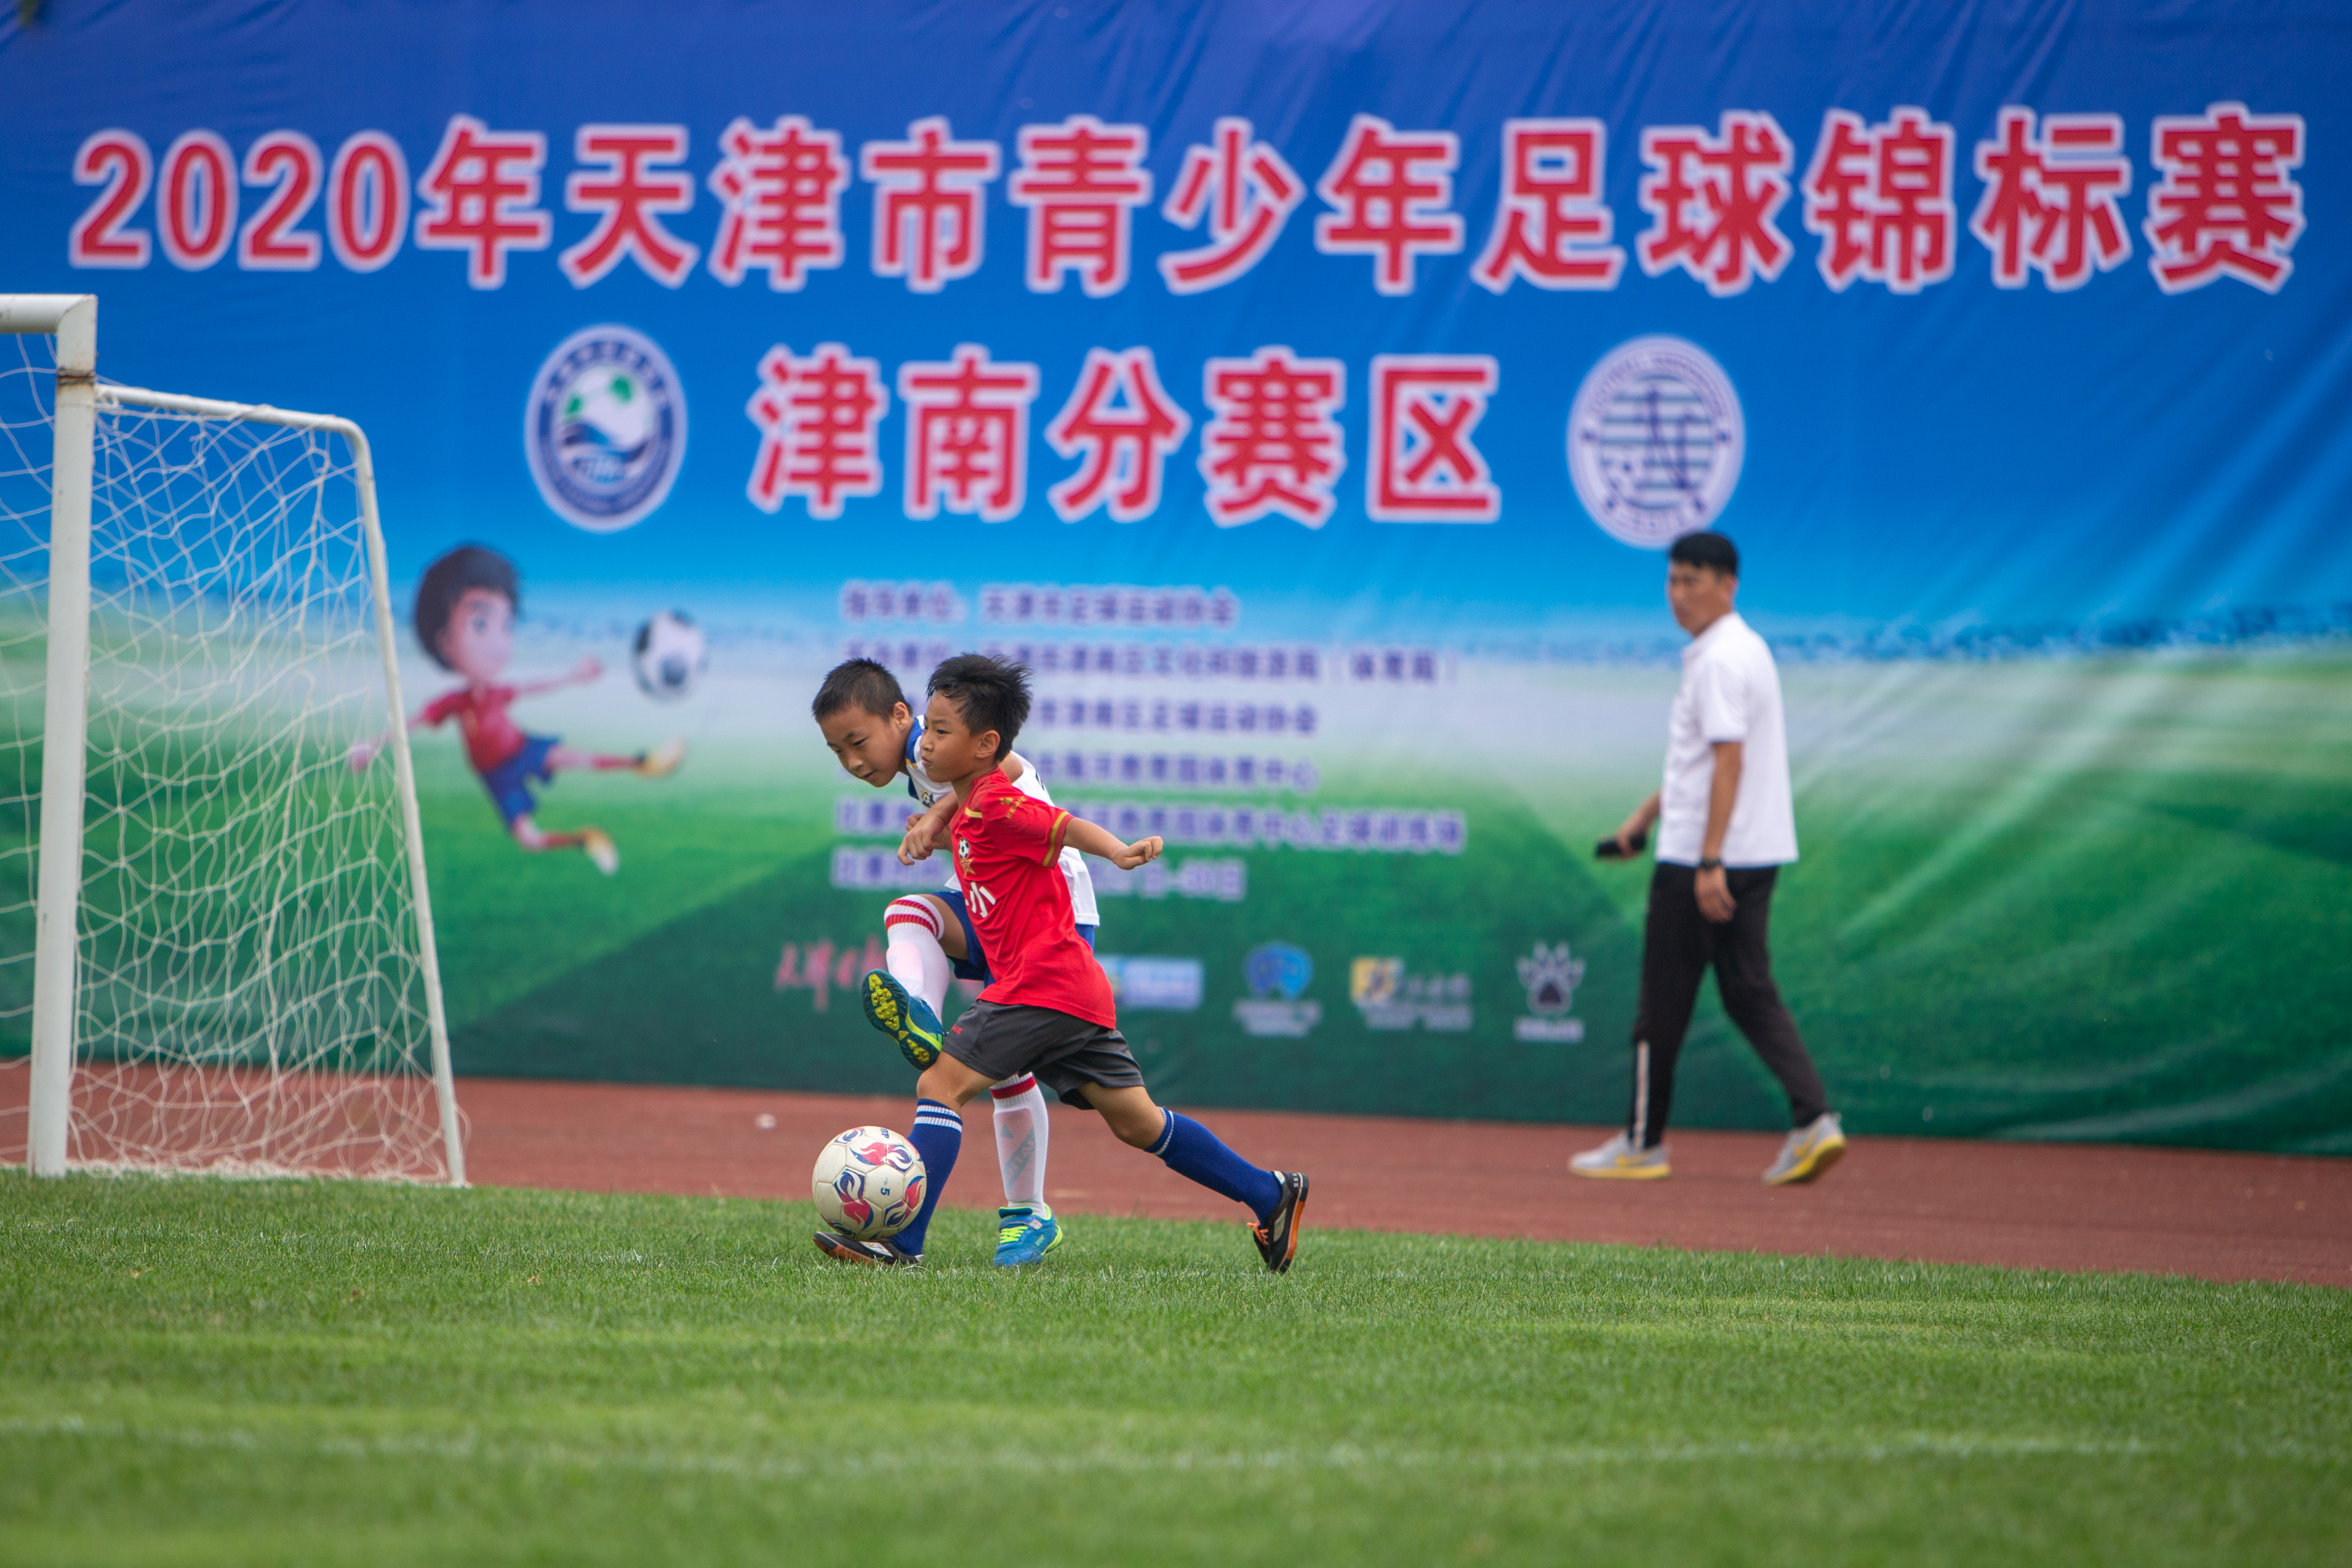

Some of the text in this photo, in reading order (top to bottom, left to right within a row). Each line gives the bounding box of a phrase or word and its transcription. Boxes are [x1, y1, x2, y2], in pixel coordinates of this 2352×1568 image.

[68, 100, 2307, 296] 2020年天津市青少年足球锦标赛
[747, 342, 1501, 527] 津南分赛区
[881, 1187, 890, 1196] 5
